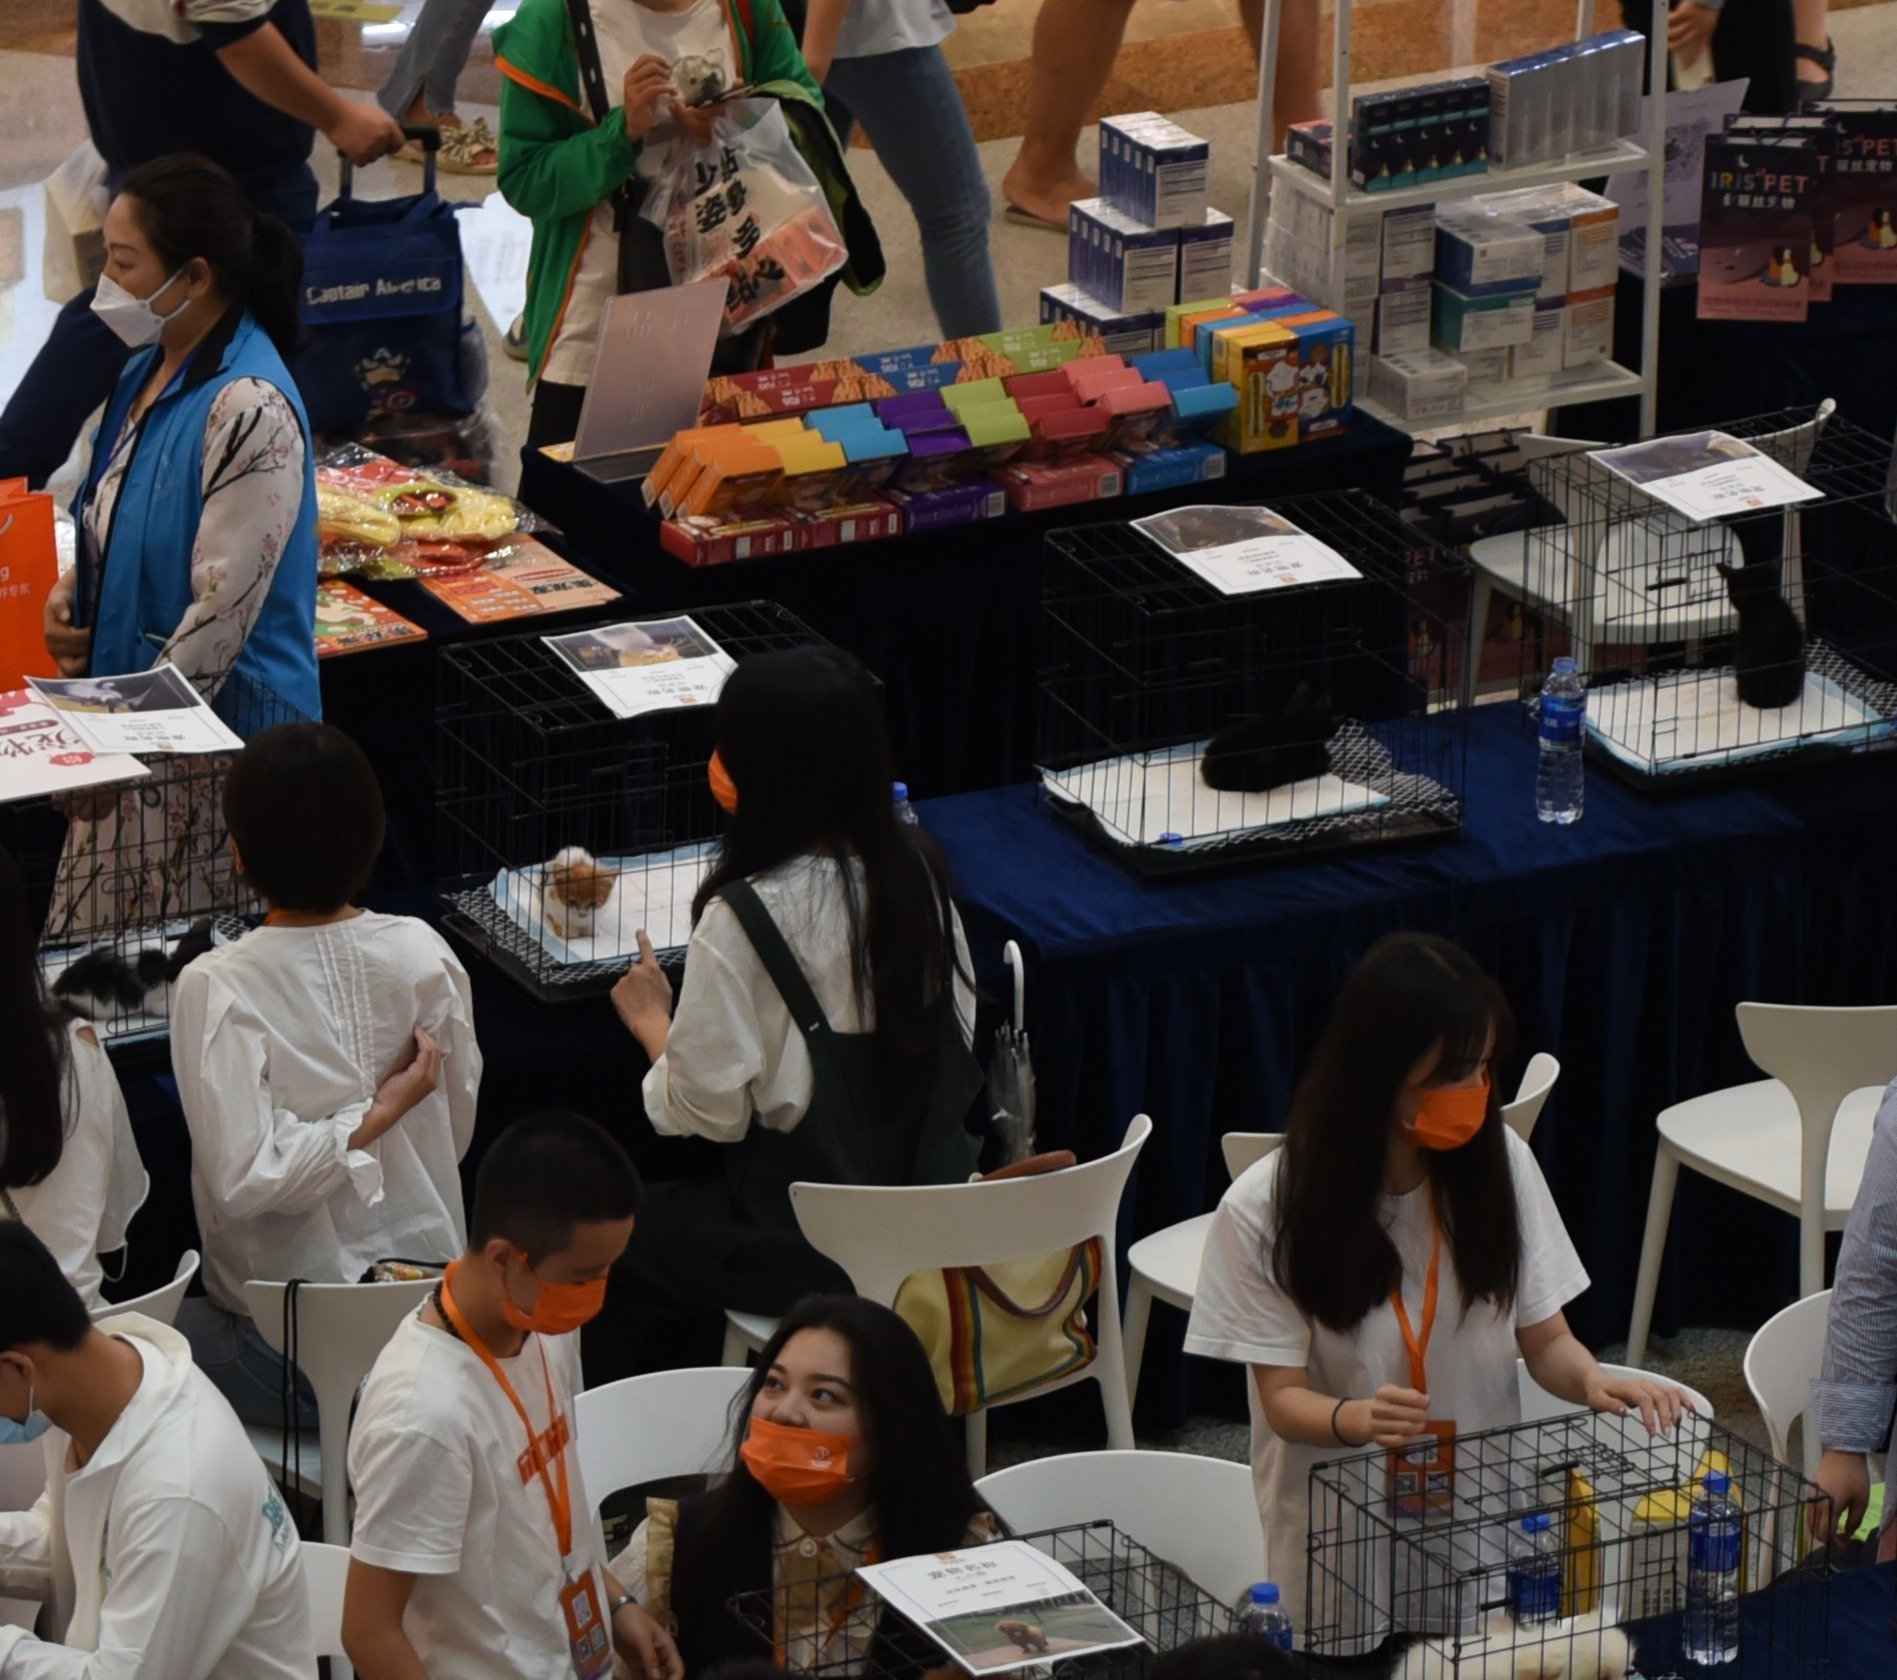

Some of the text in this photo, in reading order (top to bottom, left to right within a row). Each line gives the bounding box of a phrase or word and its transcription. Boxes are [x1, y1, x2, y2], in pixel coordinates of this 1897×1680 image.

[1763, 174, 1810, 194] PET
[306, 273, 443, 306] Captain America
